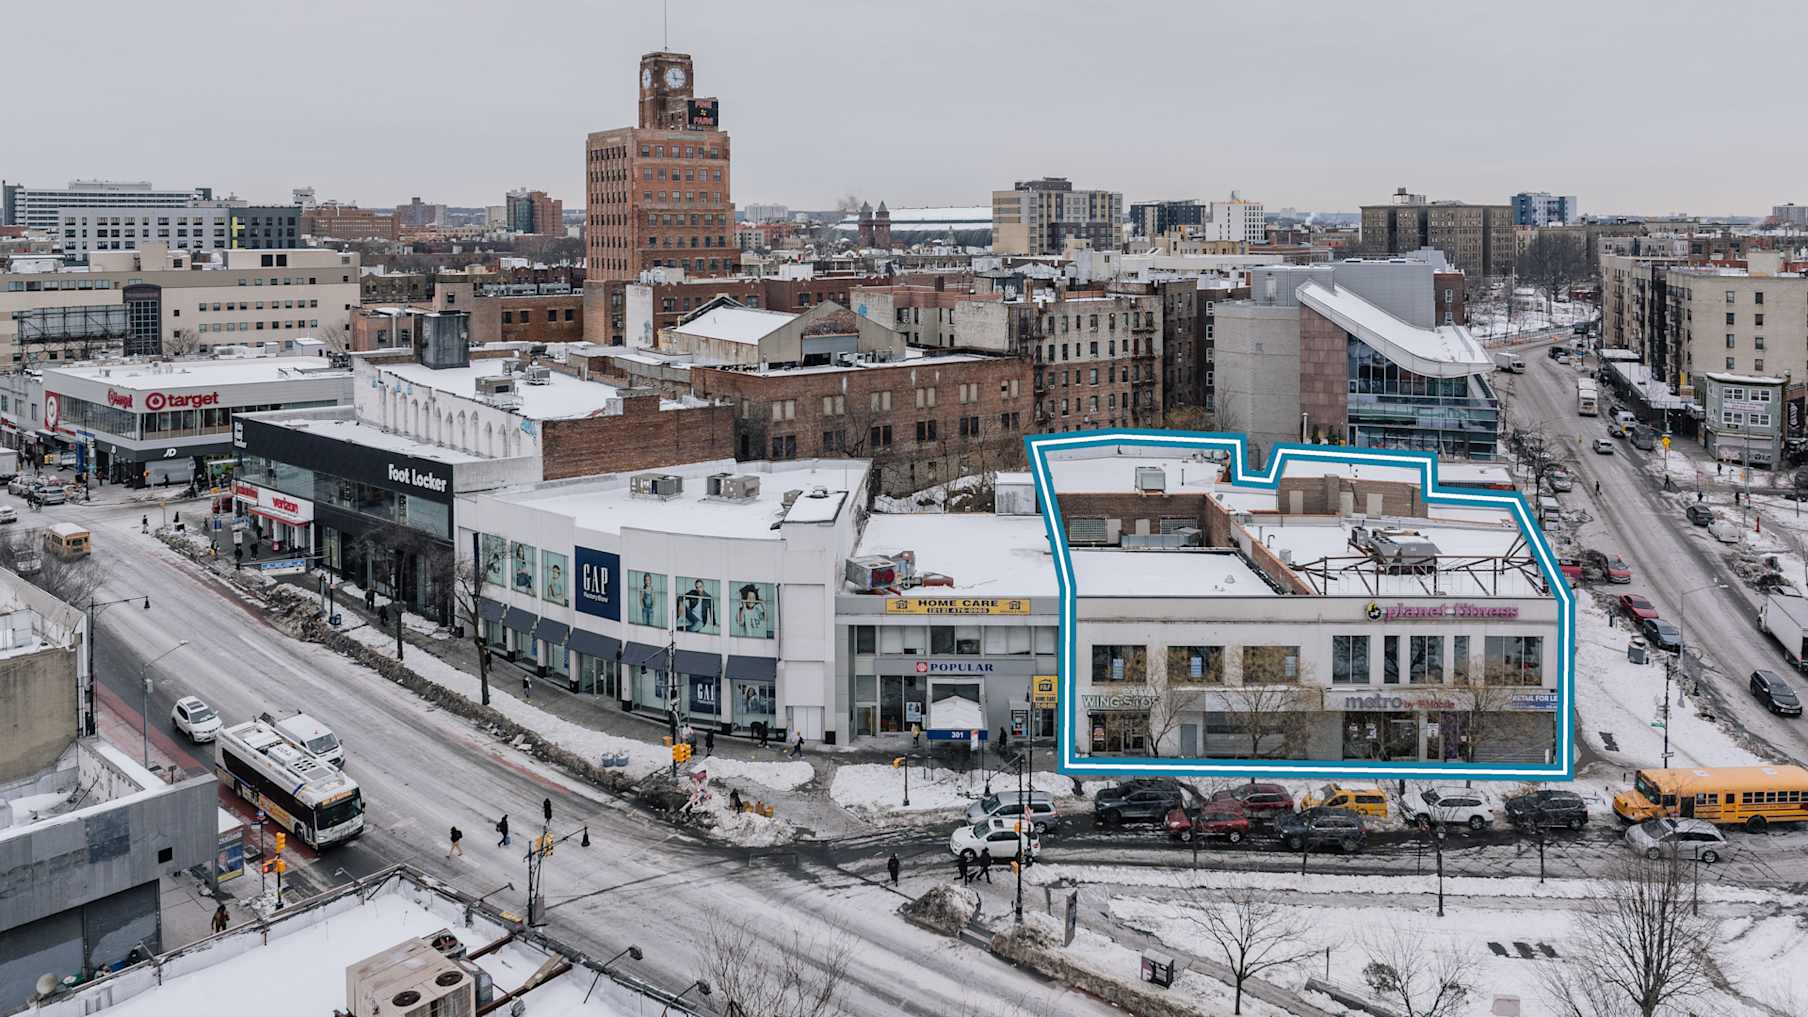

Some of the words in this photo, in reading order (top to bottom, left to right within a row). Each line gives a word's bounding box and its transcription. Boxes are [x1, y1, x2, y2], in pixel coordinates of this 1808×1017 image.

[168, 391, 219, 408] target
[163, 448, 176, 457] JD
[388, 463, 410, 484] Foot
[411, 468, 447, 493] Locker
[272, 497, 298, 513] verizon
[583, 563, 608, 595] GAP
[918, 599, 956, 607] HOME
[962, 599, 999, 607] CARE
[1386, 602, 1447, 621] planet
[1454, 602, 1519, 619] fitness
[930, 663, 993, 672] POPULAR
[1345, 693, 1401, 709] metro
[952, 731, 964, 739] 301
